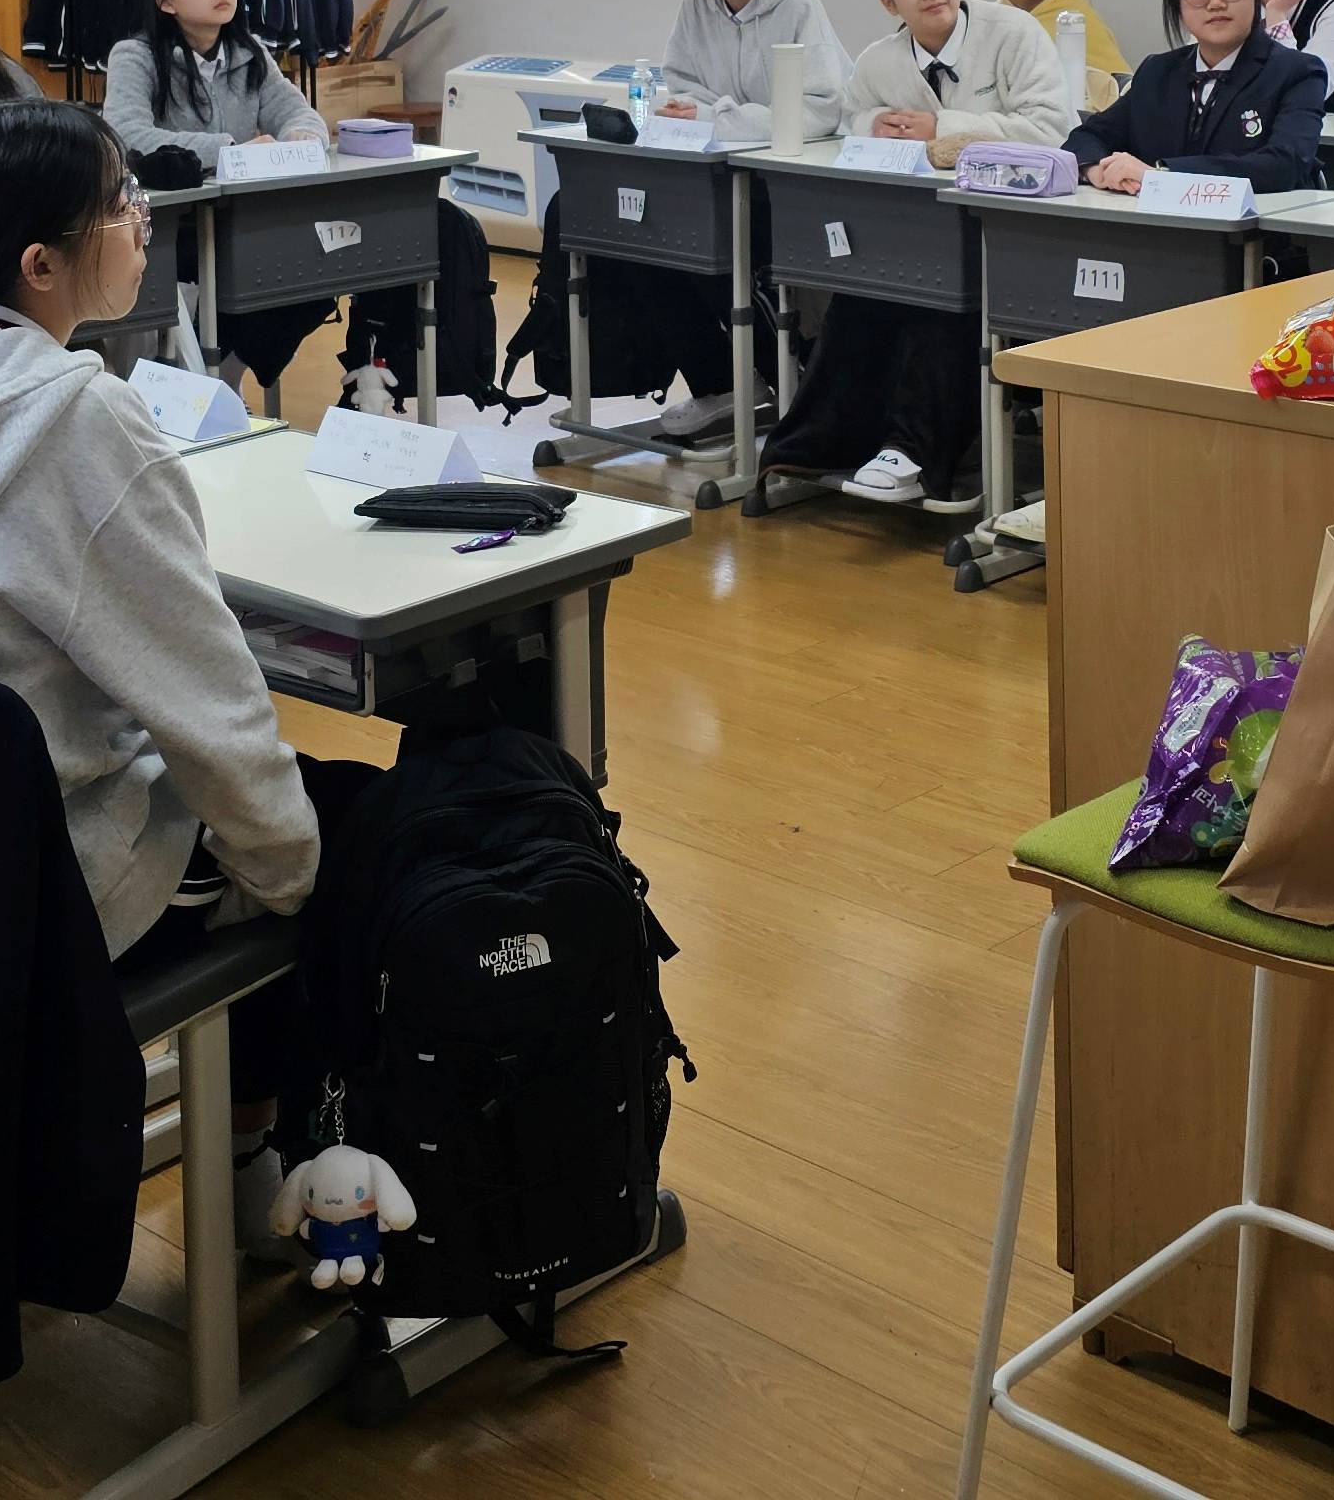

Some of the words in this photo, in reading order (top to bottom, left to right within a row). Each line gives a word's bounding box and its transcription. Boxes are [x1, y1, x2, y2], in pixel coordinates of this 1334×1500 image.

[620, 195, 643, 213] 1116
[1179, 182, 1233, 206] 서유주
[1078, 267, 1120, 290] 1111
[499, 934, 526, 950] THE
[479, 944, 526, 969] NORTH
[493, 956, 527, 978] FACE
